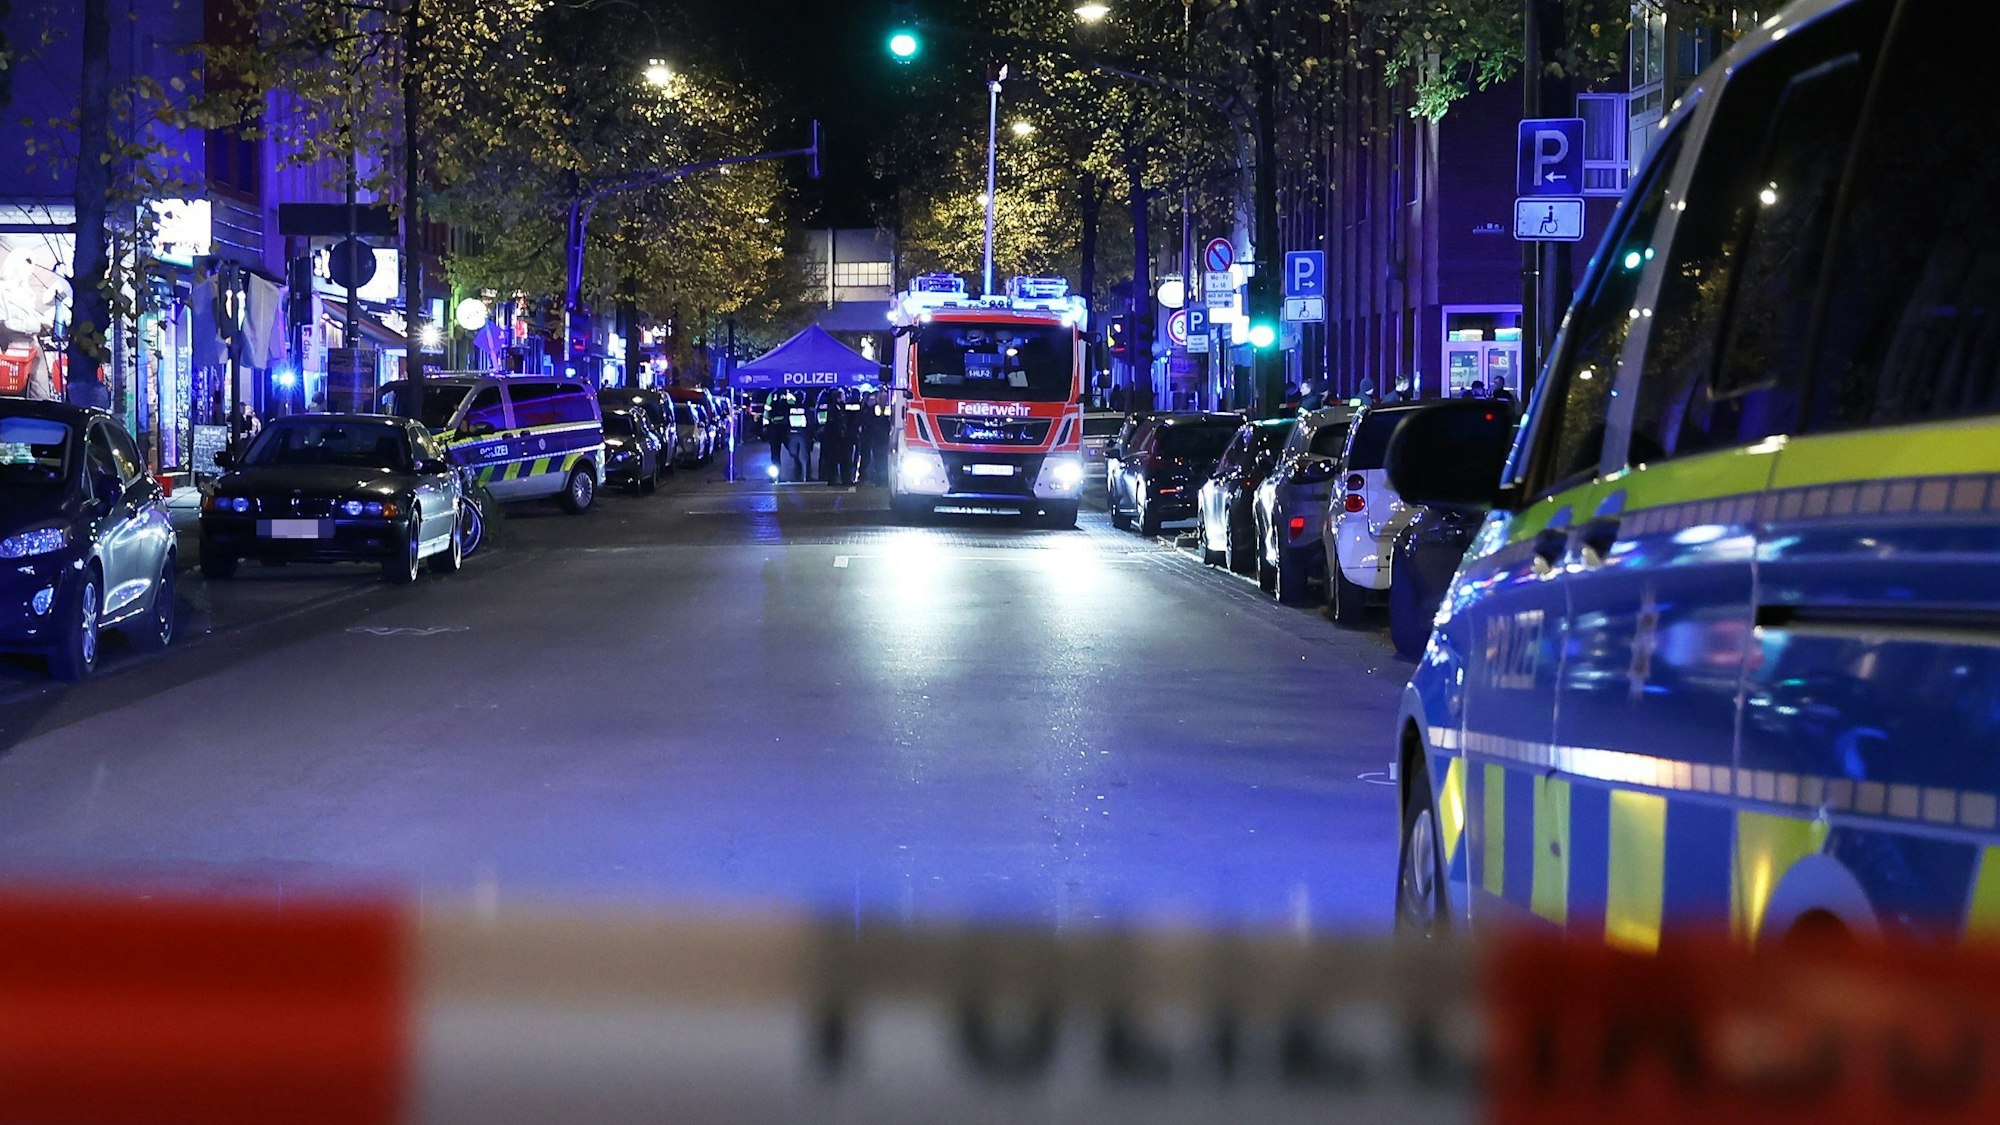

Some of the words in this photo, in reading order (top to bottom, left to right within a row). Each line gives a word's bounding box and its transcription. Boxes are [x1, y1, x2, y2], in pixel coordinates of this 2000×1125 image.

[1533, 129, 1569, 187] P
[1294, 257, 1315, 291] P
[1190, 311, 1204, 332] P
[783, 372, 838, 385] POLIZEI
[957, 401, 1032, 417] Feuerwehr
